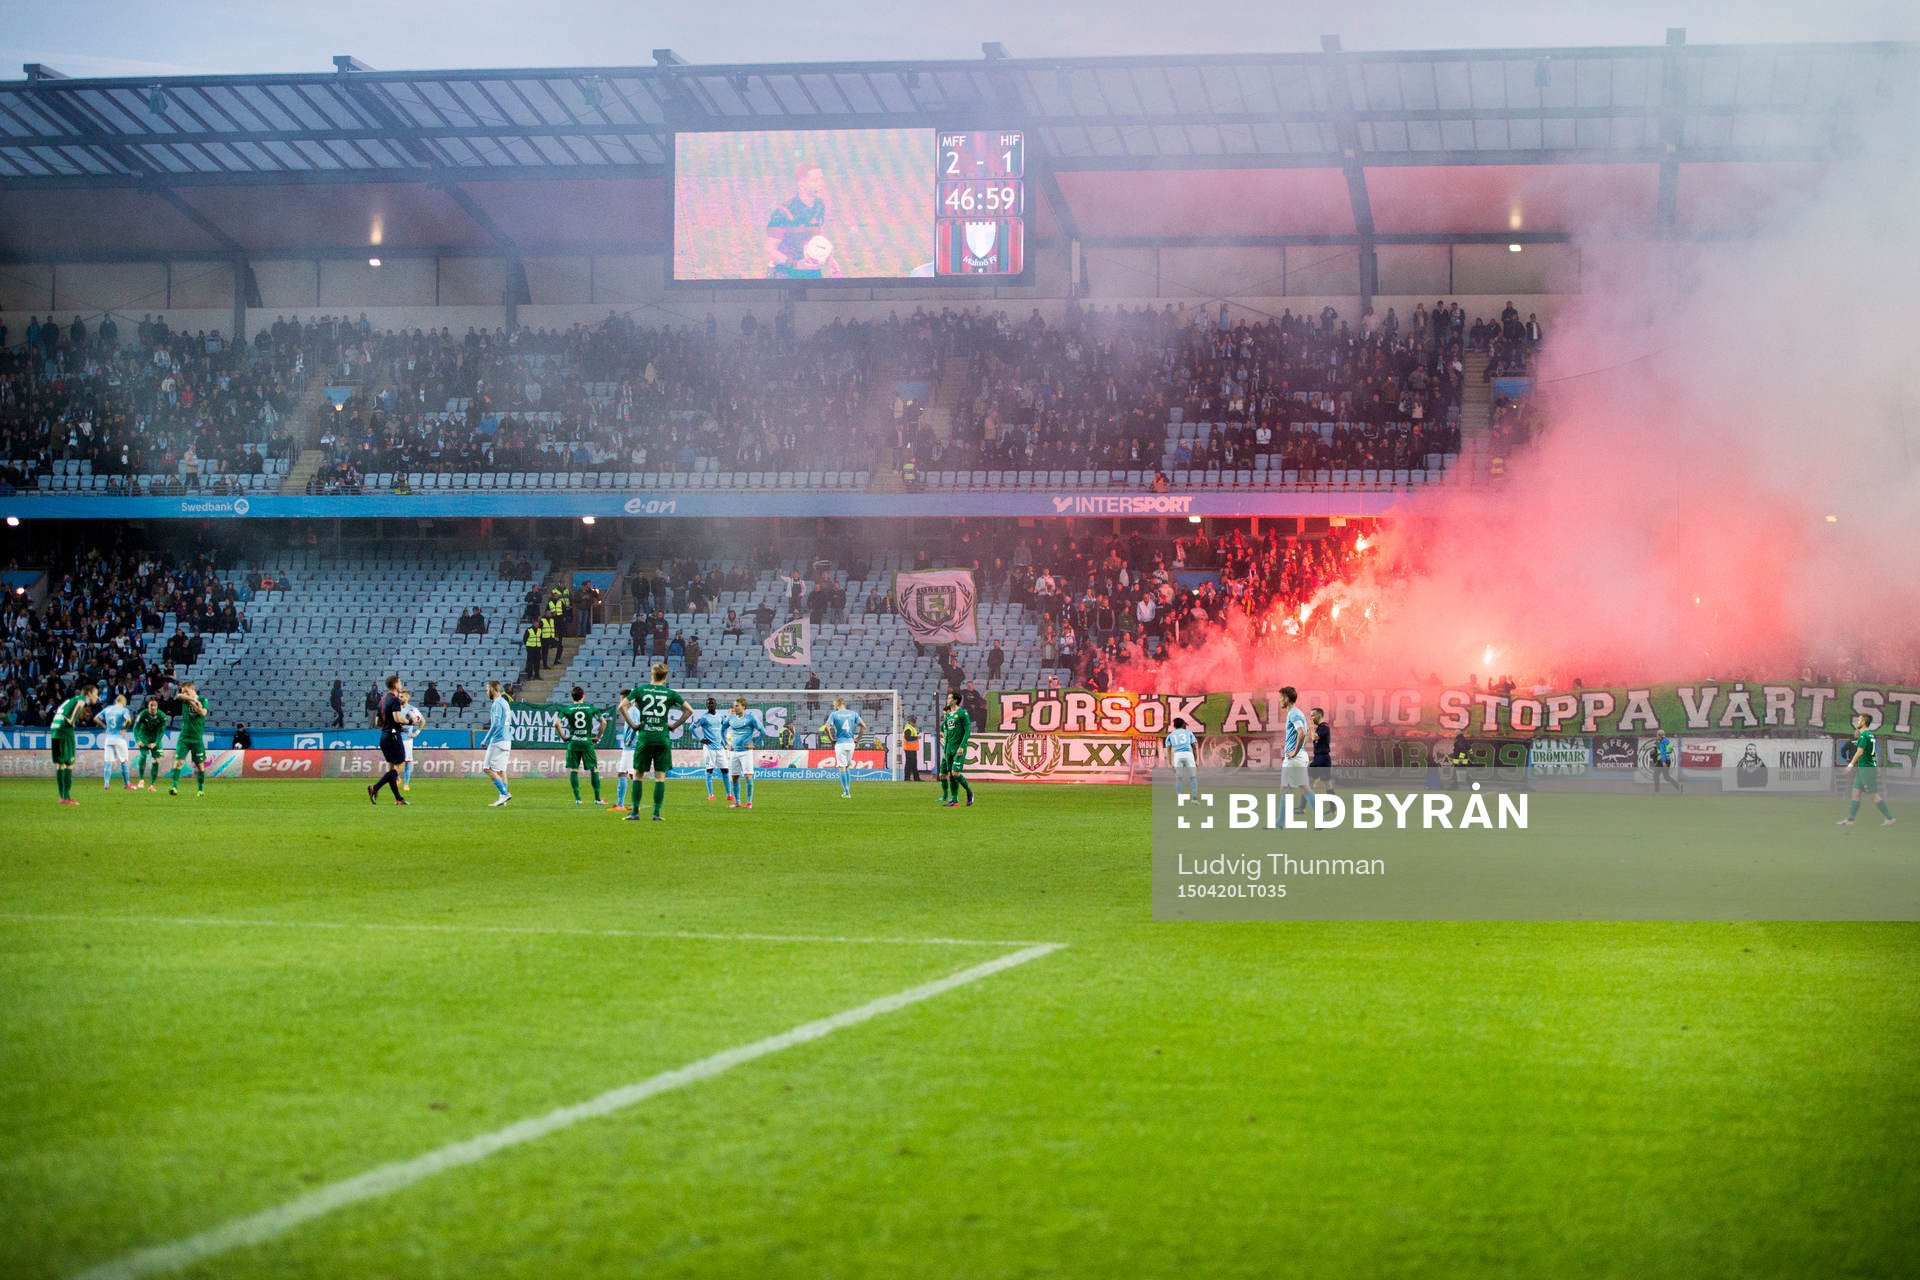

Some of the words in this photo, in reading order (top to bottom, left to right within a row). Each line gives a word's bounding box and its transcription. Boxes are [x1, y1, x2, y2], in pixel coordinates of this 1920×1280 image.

[942, 135, 966, 148] MFF
[1000, 134, 1020, 146] HIF
[946, 151, 960, 174] 2
[1002, 150, 1012, 173] 1
[944, 187, 1015, 211] 46:59
[181, 501, 233, 512] Swedbank
[1075, 496, 1194, 513] INTERSPORT
[641, 694, 668, 717] 23
[1000, 689, 1206, 733] FÖRSÖK
[1439, 690, 1660, 732] STOPPA
[1677, 683, 1835, 728] VÅRT
[110, 716, 117, 729] 3
[573, 711, 586, 729] 8
[841, 719, 850, 733] 4
[1172, 733, 1187, 744] 13
[1596, 738, 1635, 756] DEFEND
[340, 756, 372, 772] Läs
[423, 761, 454, 772] om
[1532, 750, 1586, 763] DRÖMMARS
[1779, 751, 1823, 768] KENNEDY
[753, 768, 781, 781] priset
[783, 768, 804, 779] med
[805, 768, 840, 779] BroPass
[1532, 763, 1586, 776] STAD
